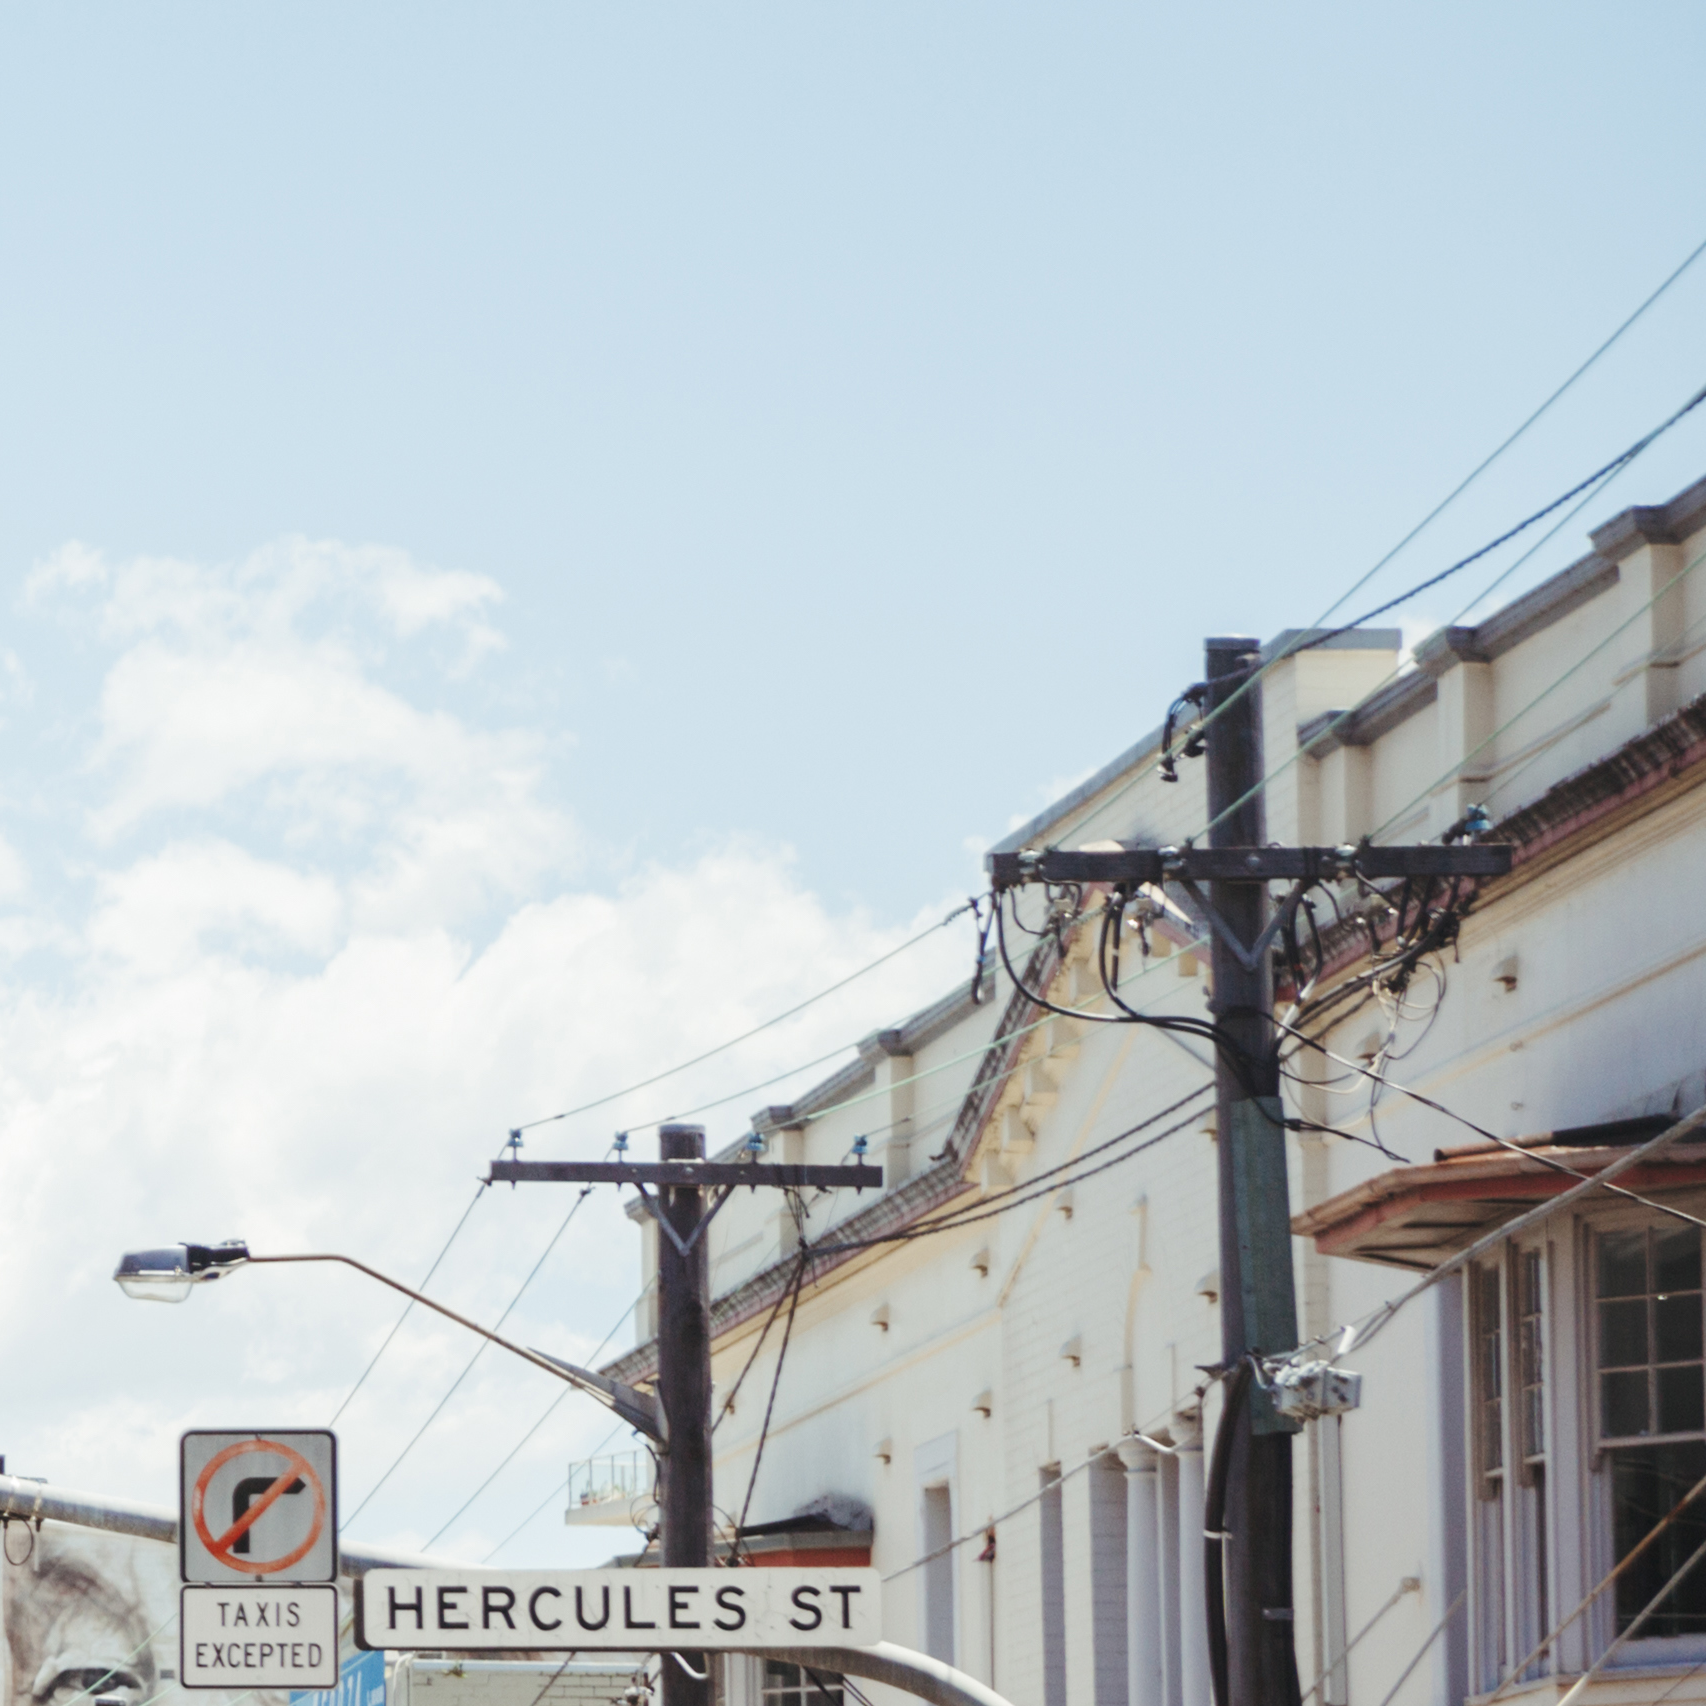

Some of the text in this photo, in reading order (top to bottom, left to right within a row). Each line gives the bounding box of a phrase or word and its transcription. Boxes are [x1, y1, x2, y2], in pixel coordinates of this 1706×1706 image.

[218, 1602, 301, 1628] TAXIS
[387, 1584, 862, 1632] HERCULES ST
[194, 1643, 323, 1669] EXCEPTED
